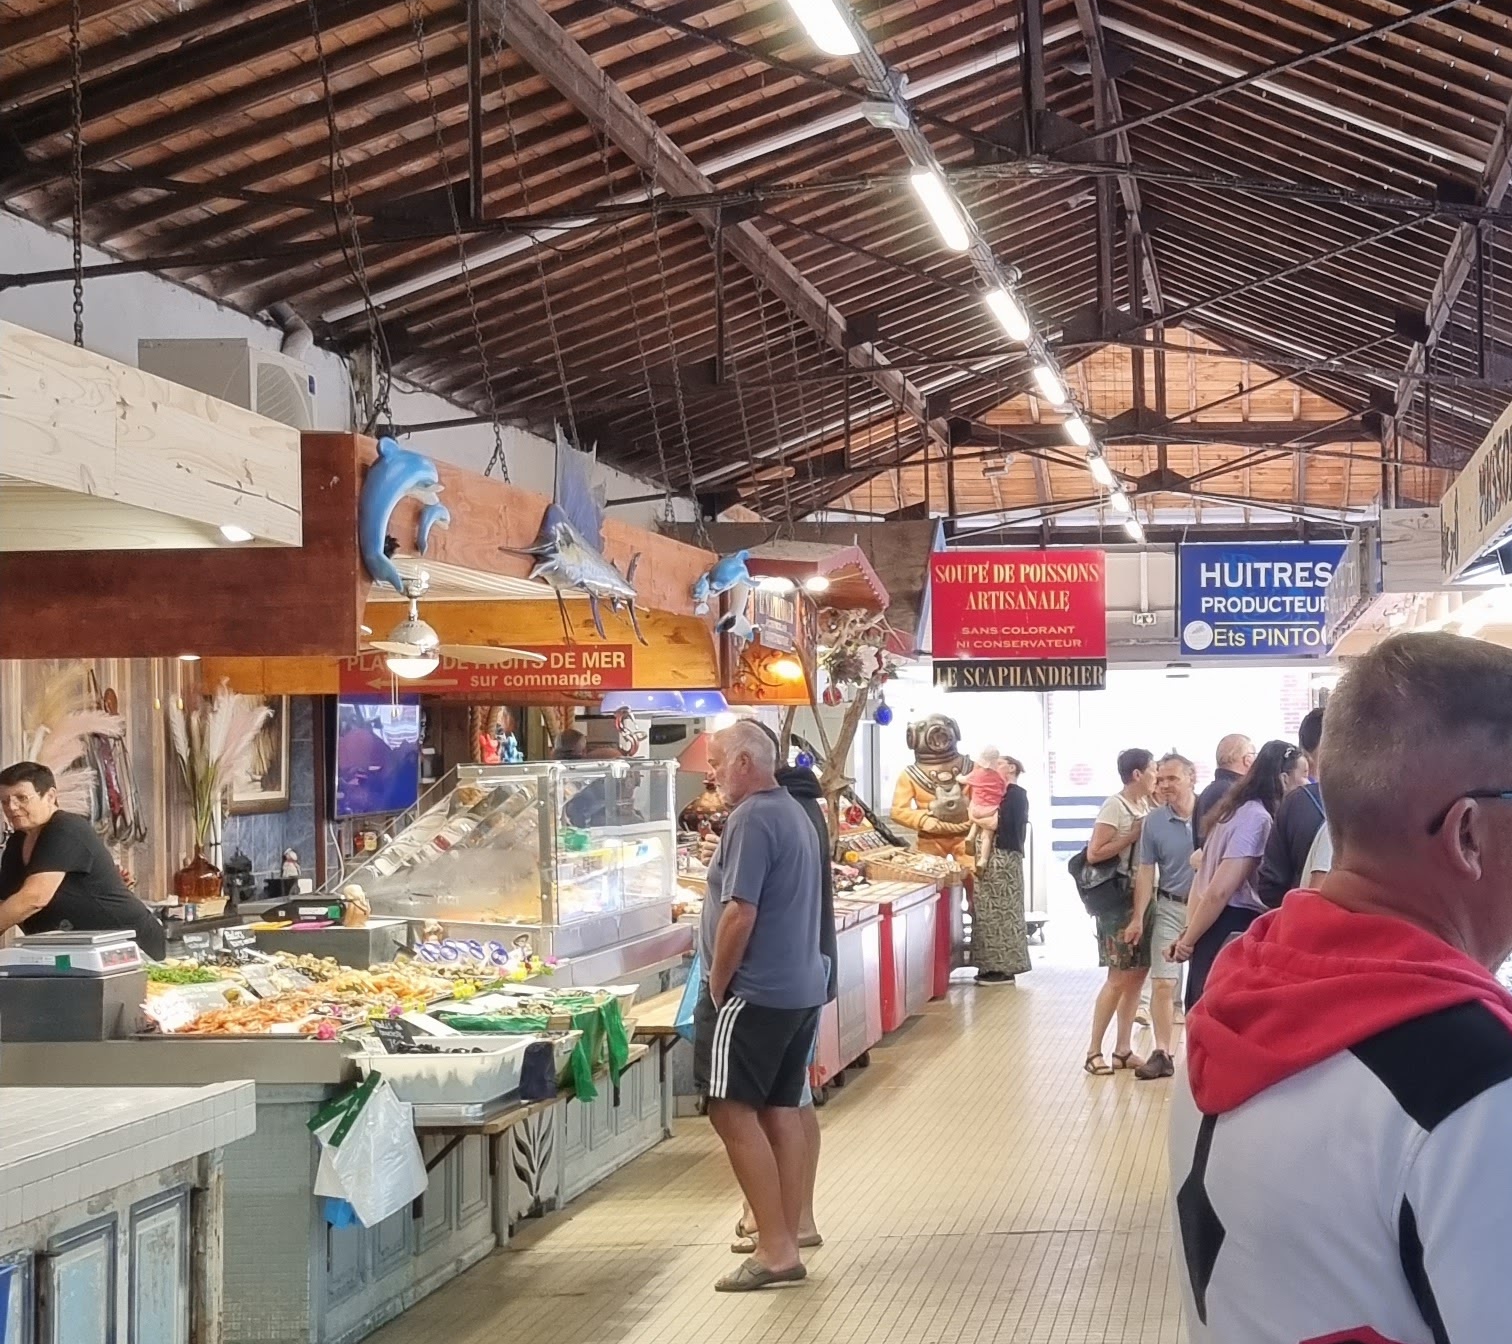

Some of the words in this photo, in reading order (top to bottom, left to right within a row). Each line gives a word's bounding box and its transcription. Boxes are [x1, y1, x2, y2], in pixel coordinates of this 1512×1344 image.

[935, 563, 989, 583] SOUPE
[994, 563, 1015, 583] DE
[1020, 563, 1099, 583] POISSONS
[1200, 562, 1333, 587] HUITRES
[966, 590, 1070, 610] ARTISANALE
[962, 627, 997, 635] SANS
[1002, 626, 1075, 635] COLORANT
[1214, 628, 1245, 646] Ets
[974, 640, 1082, 648] CONSERVATEUR
[550, 653, 575, 668] DE
[582, 652, 625, 668] MER
[470, 674, 497, 687] sur
[503, 671, 602, 686] commande
[936, 667, 958, 687] LE
[964, 666, 1103, 687] SCAPHANDRIER
